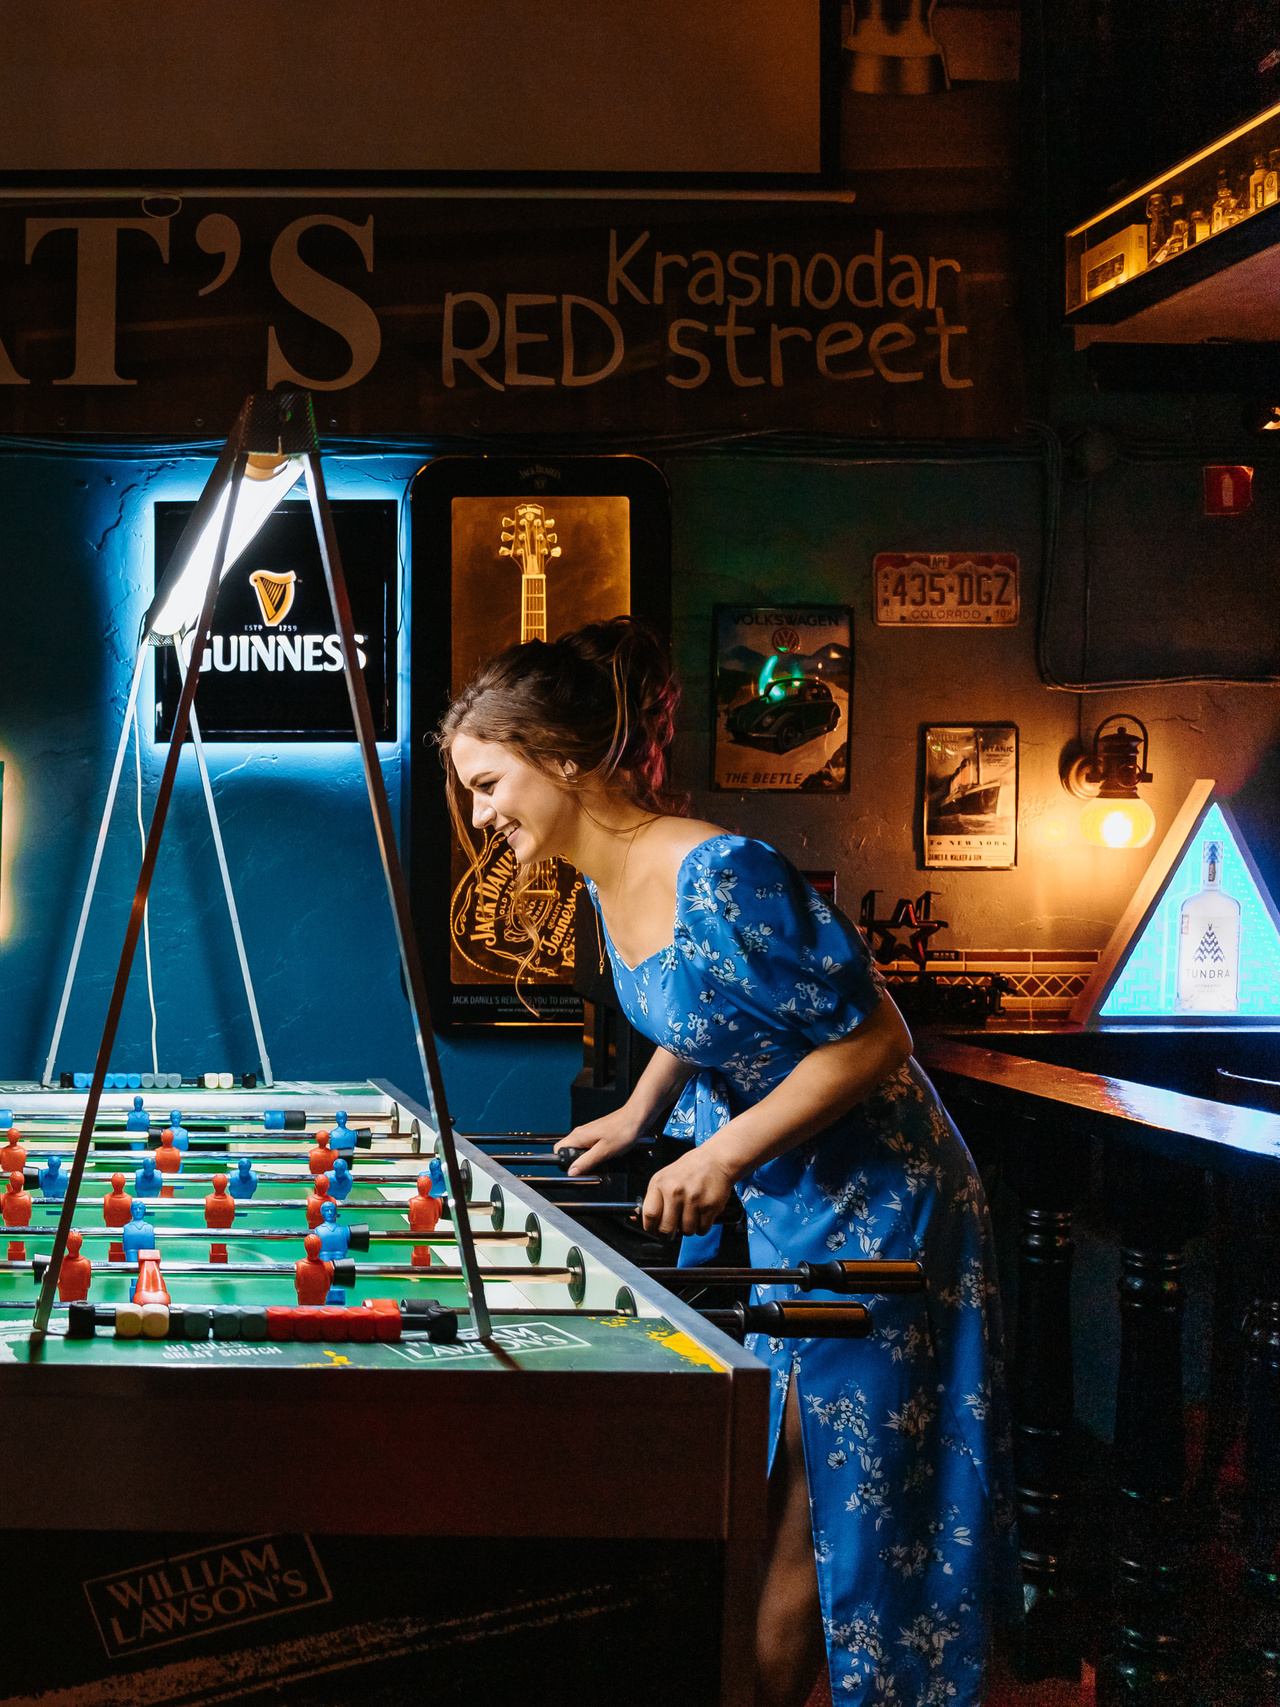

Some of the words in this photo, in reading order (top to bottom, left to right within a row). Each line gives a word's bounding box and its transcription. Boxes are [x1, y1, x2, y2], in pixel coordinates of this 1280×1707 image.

[607, 229, 961, 309] Krasnodar
[442, 292, 624, 391] RED
[666, 300, 974, 389] street
[731, 613, 839, 627] VOLKSWAGEN
[911, 610, 982, 620] COLORADO
[981, 745, 1014, 753] TITANIC
[725, 772, 748, 784] THE
[751, 773, 803, 785] BEETLE
[474, 849, 515, 900] DANIE
[499, 898, 508, 915] OLD
[547, 901, 563, 930] QUALITY
[470, 901, 497, 946] JACK
[1186, 969, 1230, 979] TUNDRA
[452, 996, 468, 1005] JACK
[469, 996, 499, 1005] DANIEL'S
[534, 996, 548, 1005] YOU
[549, 996, 558, 1005] TO
[559, 996, 580, 1005] DRINK
[162, 1350, 214, 1360] GREAT
[218, 1346, 283, 1357] SCOTCH
[164, 1344, 187, 1352] NO
[106, 1543, 280, 1610] WILLIAM
[110, 1569, 308, 1646] LAWSON'S
